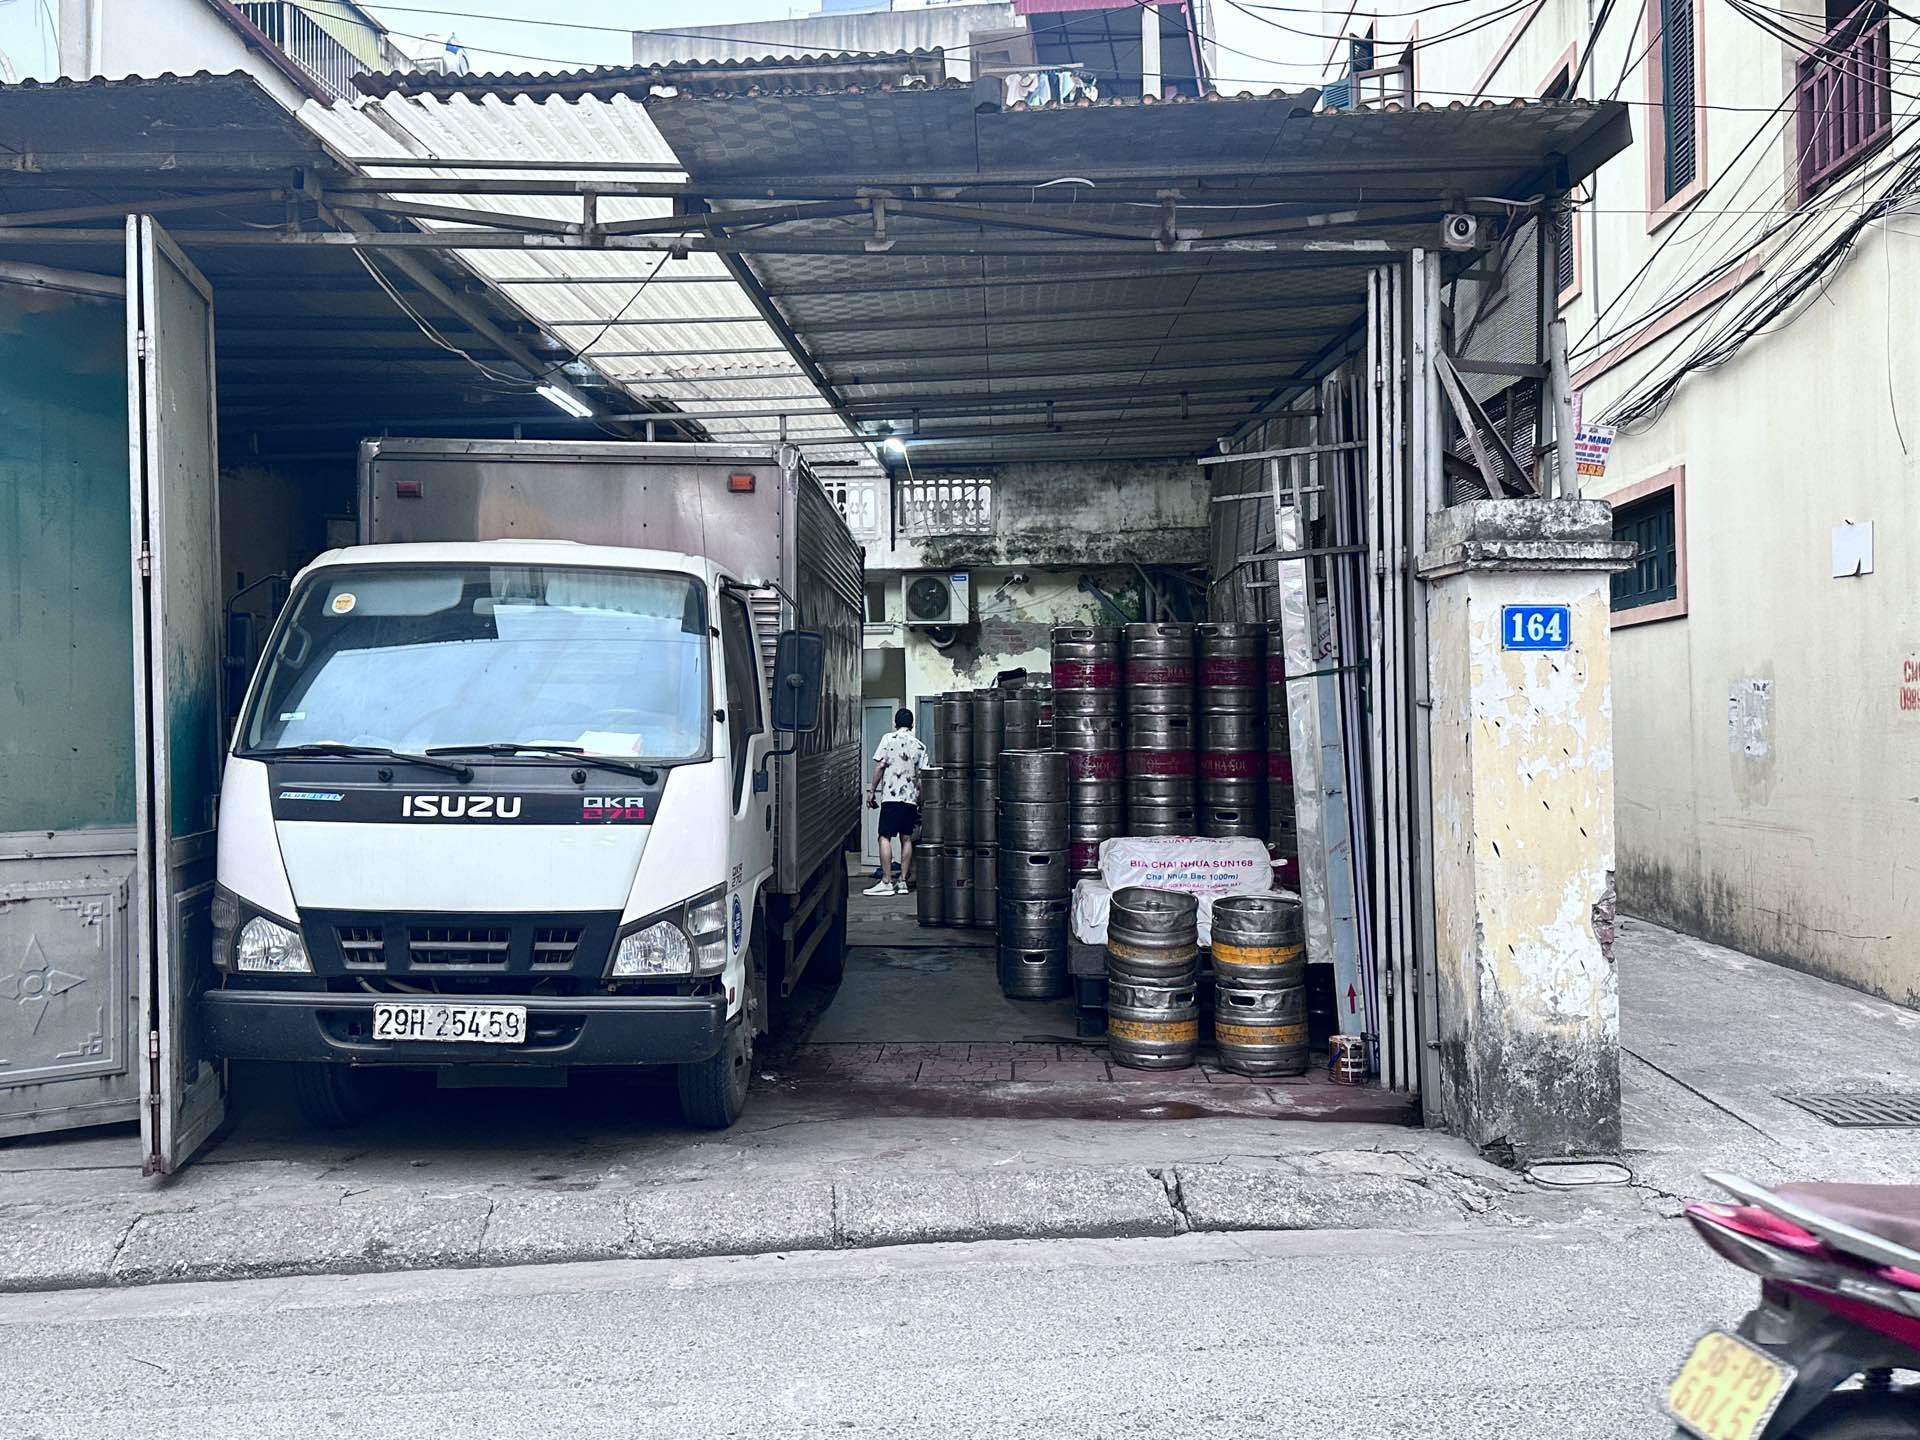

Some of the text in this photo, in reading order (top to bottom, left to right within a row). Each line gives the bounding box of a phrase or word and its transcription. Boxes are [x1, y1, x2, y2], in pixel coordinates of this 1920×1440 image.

[1512, 613, 1562, 642] 164
[1904, 660, 1920, 683] CH
[402, 796, 522, 819] ISUZU
[583, 797, 644, 808] QKR
[583, 809, 644, 820] 270
[1130, 860, 1148, 868] BIA
[1151, 861, 1177, 869] CHAI
[1212, 860, 1254, 868] SUN168
